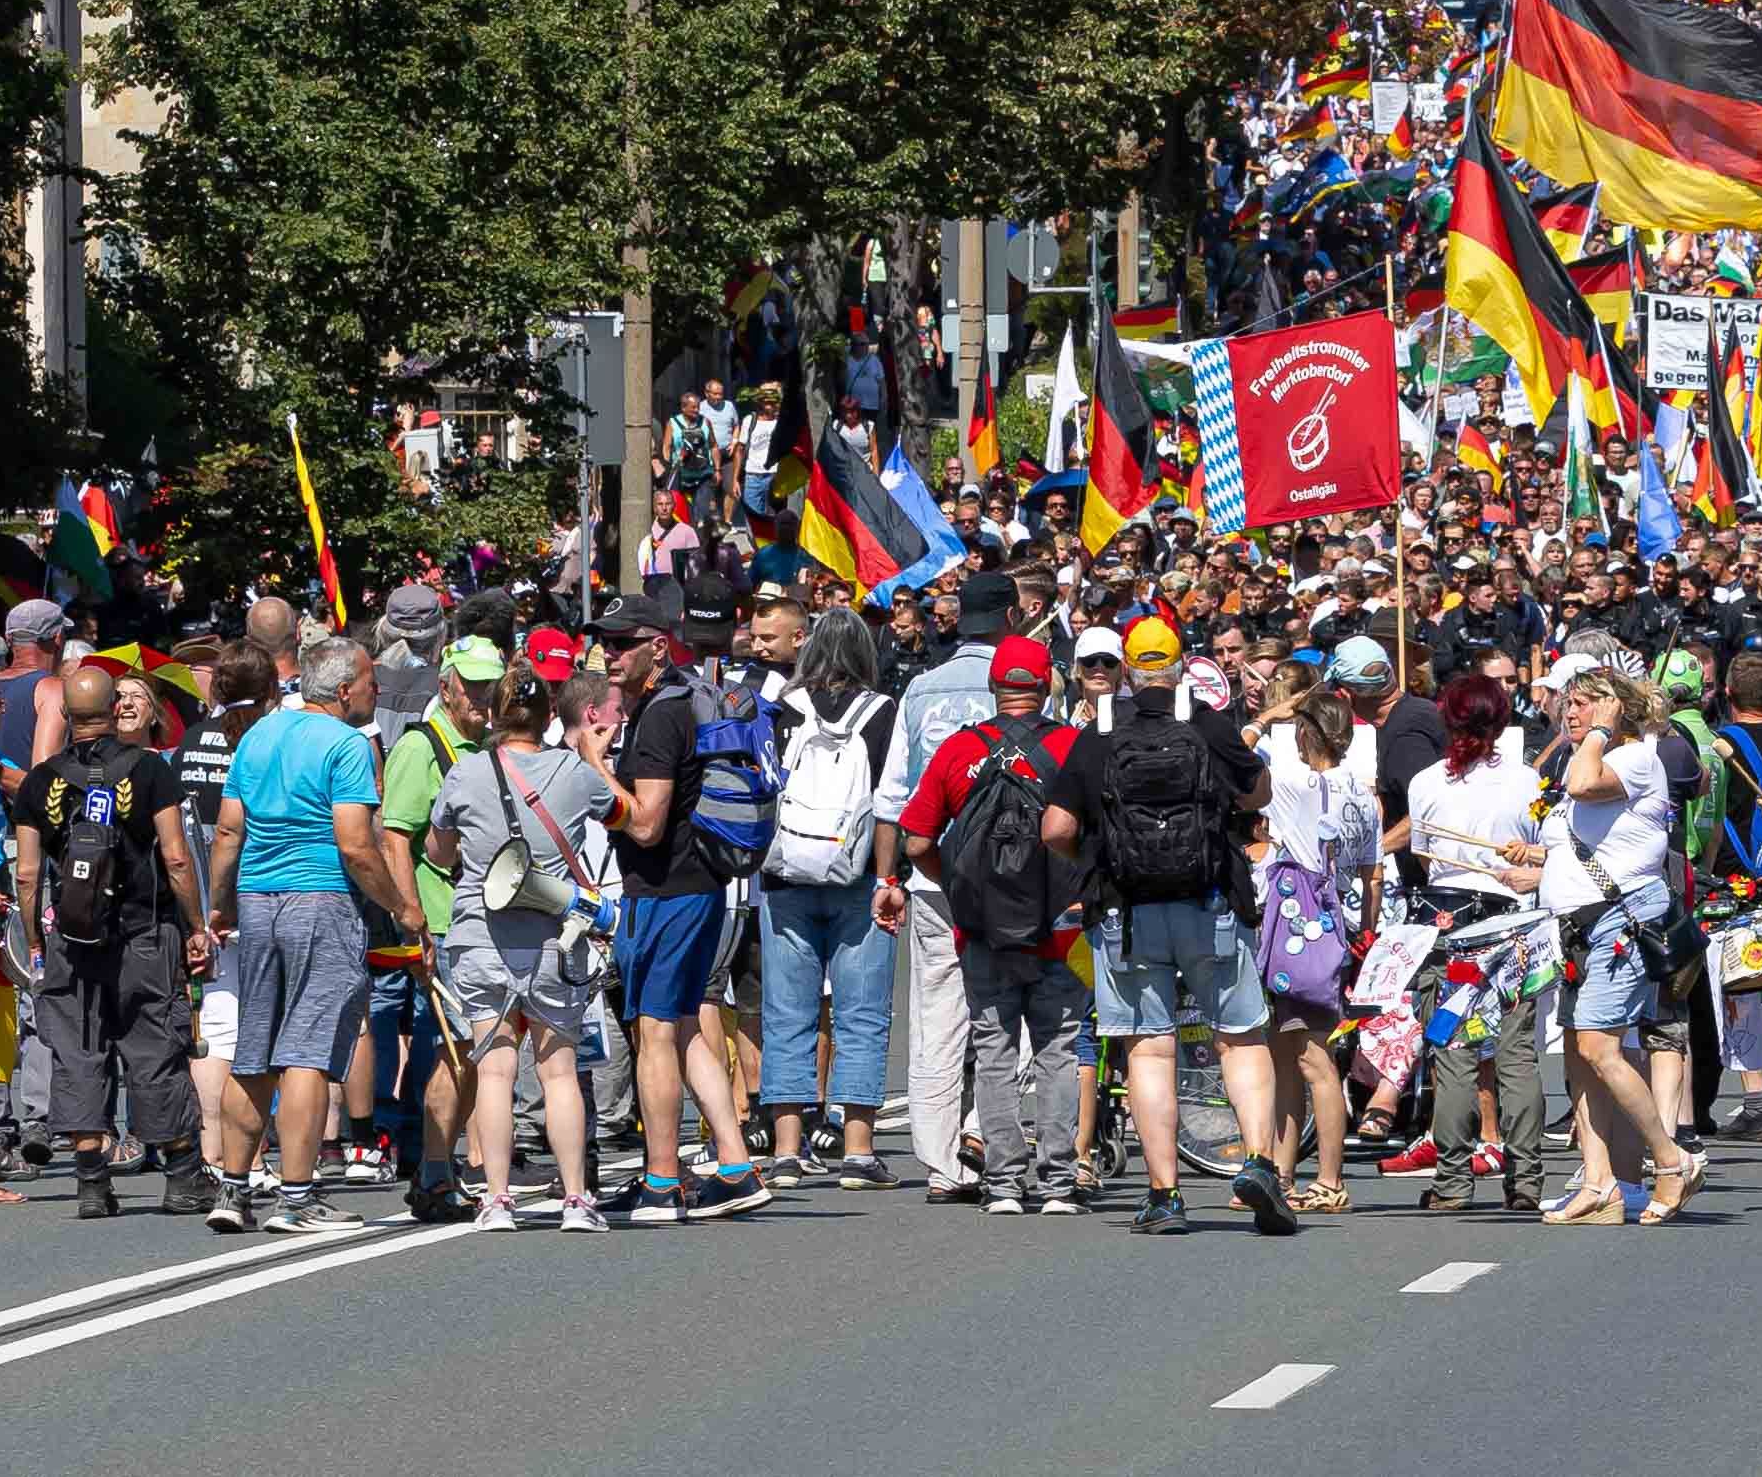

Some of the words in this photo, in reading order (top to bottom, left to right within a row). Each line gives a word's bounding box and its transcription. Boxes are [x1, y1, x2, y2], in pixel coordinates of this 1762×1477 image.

[1653, 300, 1704, 322] Das
[1270, 363, 1354, 404] Marktoberdorf
[1289, 481, 1338, 503] Ostallgäu
